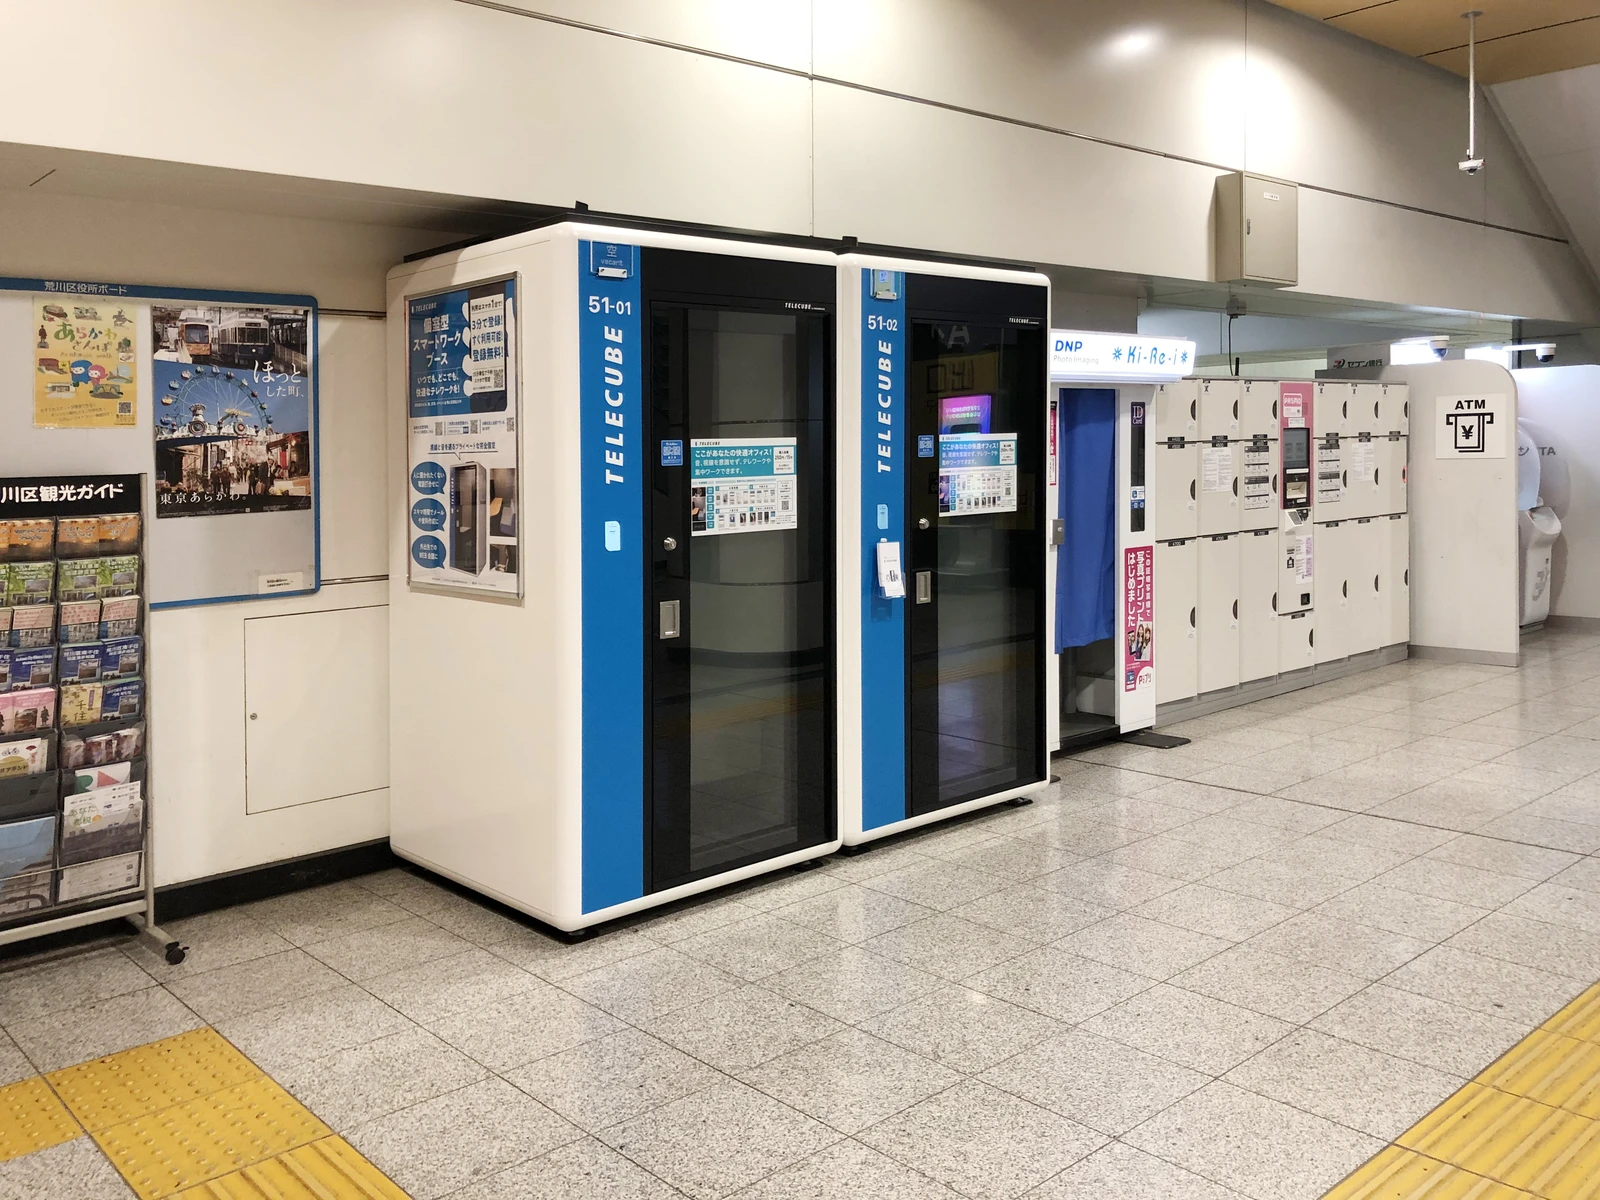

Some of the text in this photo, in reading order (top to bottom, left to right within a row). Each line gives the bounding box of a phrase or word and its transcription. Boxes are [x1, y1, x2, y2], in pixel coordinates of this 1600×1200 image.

[44, 281, 127, 295] 荒川区役所ボード
[589, 295, 631, 316] 51-01
[784, 302, 812, 310] TELECUBE
[424, 314, 450, 334] 個室型
[867, 315, 898, 331] 51-02
[54, 321, 117, 342] あらかわ
[73, 340, 113, 352] さんぽ
[413, 331, 462, 351] スマートワーク
[1055, 340, 1083, 352] DNP
[426, 352, 448, 368] ブース
[1053, 354, 1099, 365] Photo Imaging
[253, 360, 302, 383] ほっと
[417, 372, 459, 384] いつでも、どこでも、
[604, 325, 624, 484] TELECUBE
[877, 340, 892, 473] TELECUBE
[1132, 405, 1144, 418] ID
[1455, 400, 1486, 410] ATM
[695, 449, 772, 458] ここがあなたの快適オフィス!
[1127, 552, 1136, 627] はじめました
[1136, 551, 1145, 624] 写真プリント
[74, 700, 87, 721] 千住
